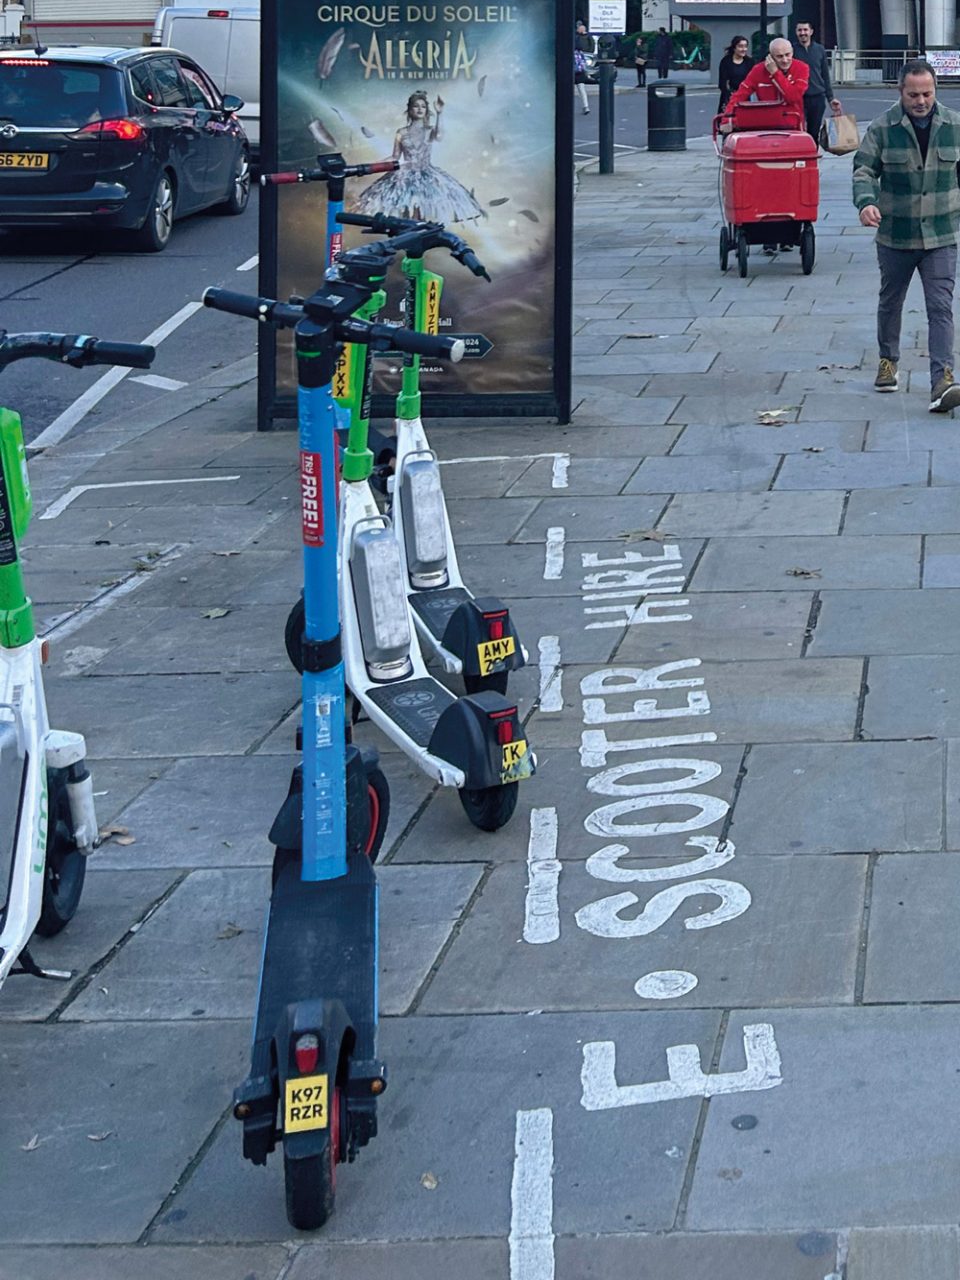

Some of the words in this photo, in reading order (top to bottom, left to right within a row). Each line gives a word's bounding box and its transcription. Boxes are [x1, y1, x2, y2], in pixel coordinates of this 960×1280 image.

[317, 5, 400, 28] CIRQUE
[407, 5, 437, 22] DU
[443, 5, 517, 23] SOLEIL
[399, 72, 405, 80] A
[408, 72, 423, 80] NEW
[427, 72, 449, 80] LIGHT
[17, 154, 44, 167] ZYD
[302, 474, 319, 529] FREE!
[582, 544, 693, 630] HIRE
[484, 639, 509, 658] AMY
[291, 1085, 323, 1104] K97
[290, 1103, 323, 1122] RZR
